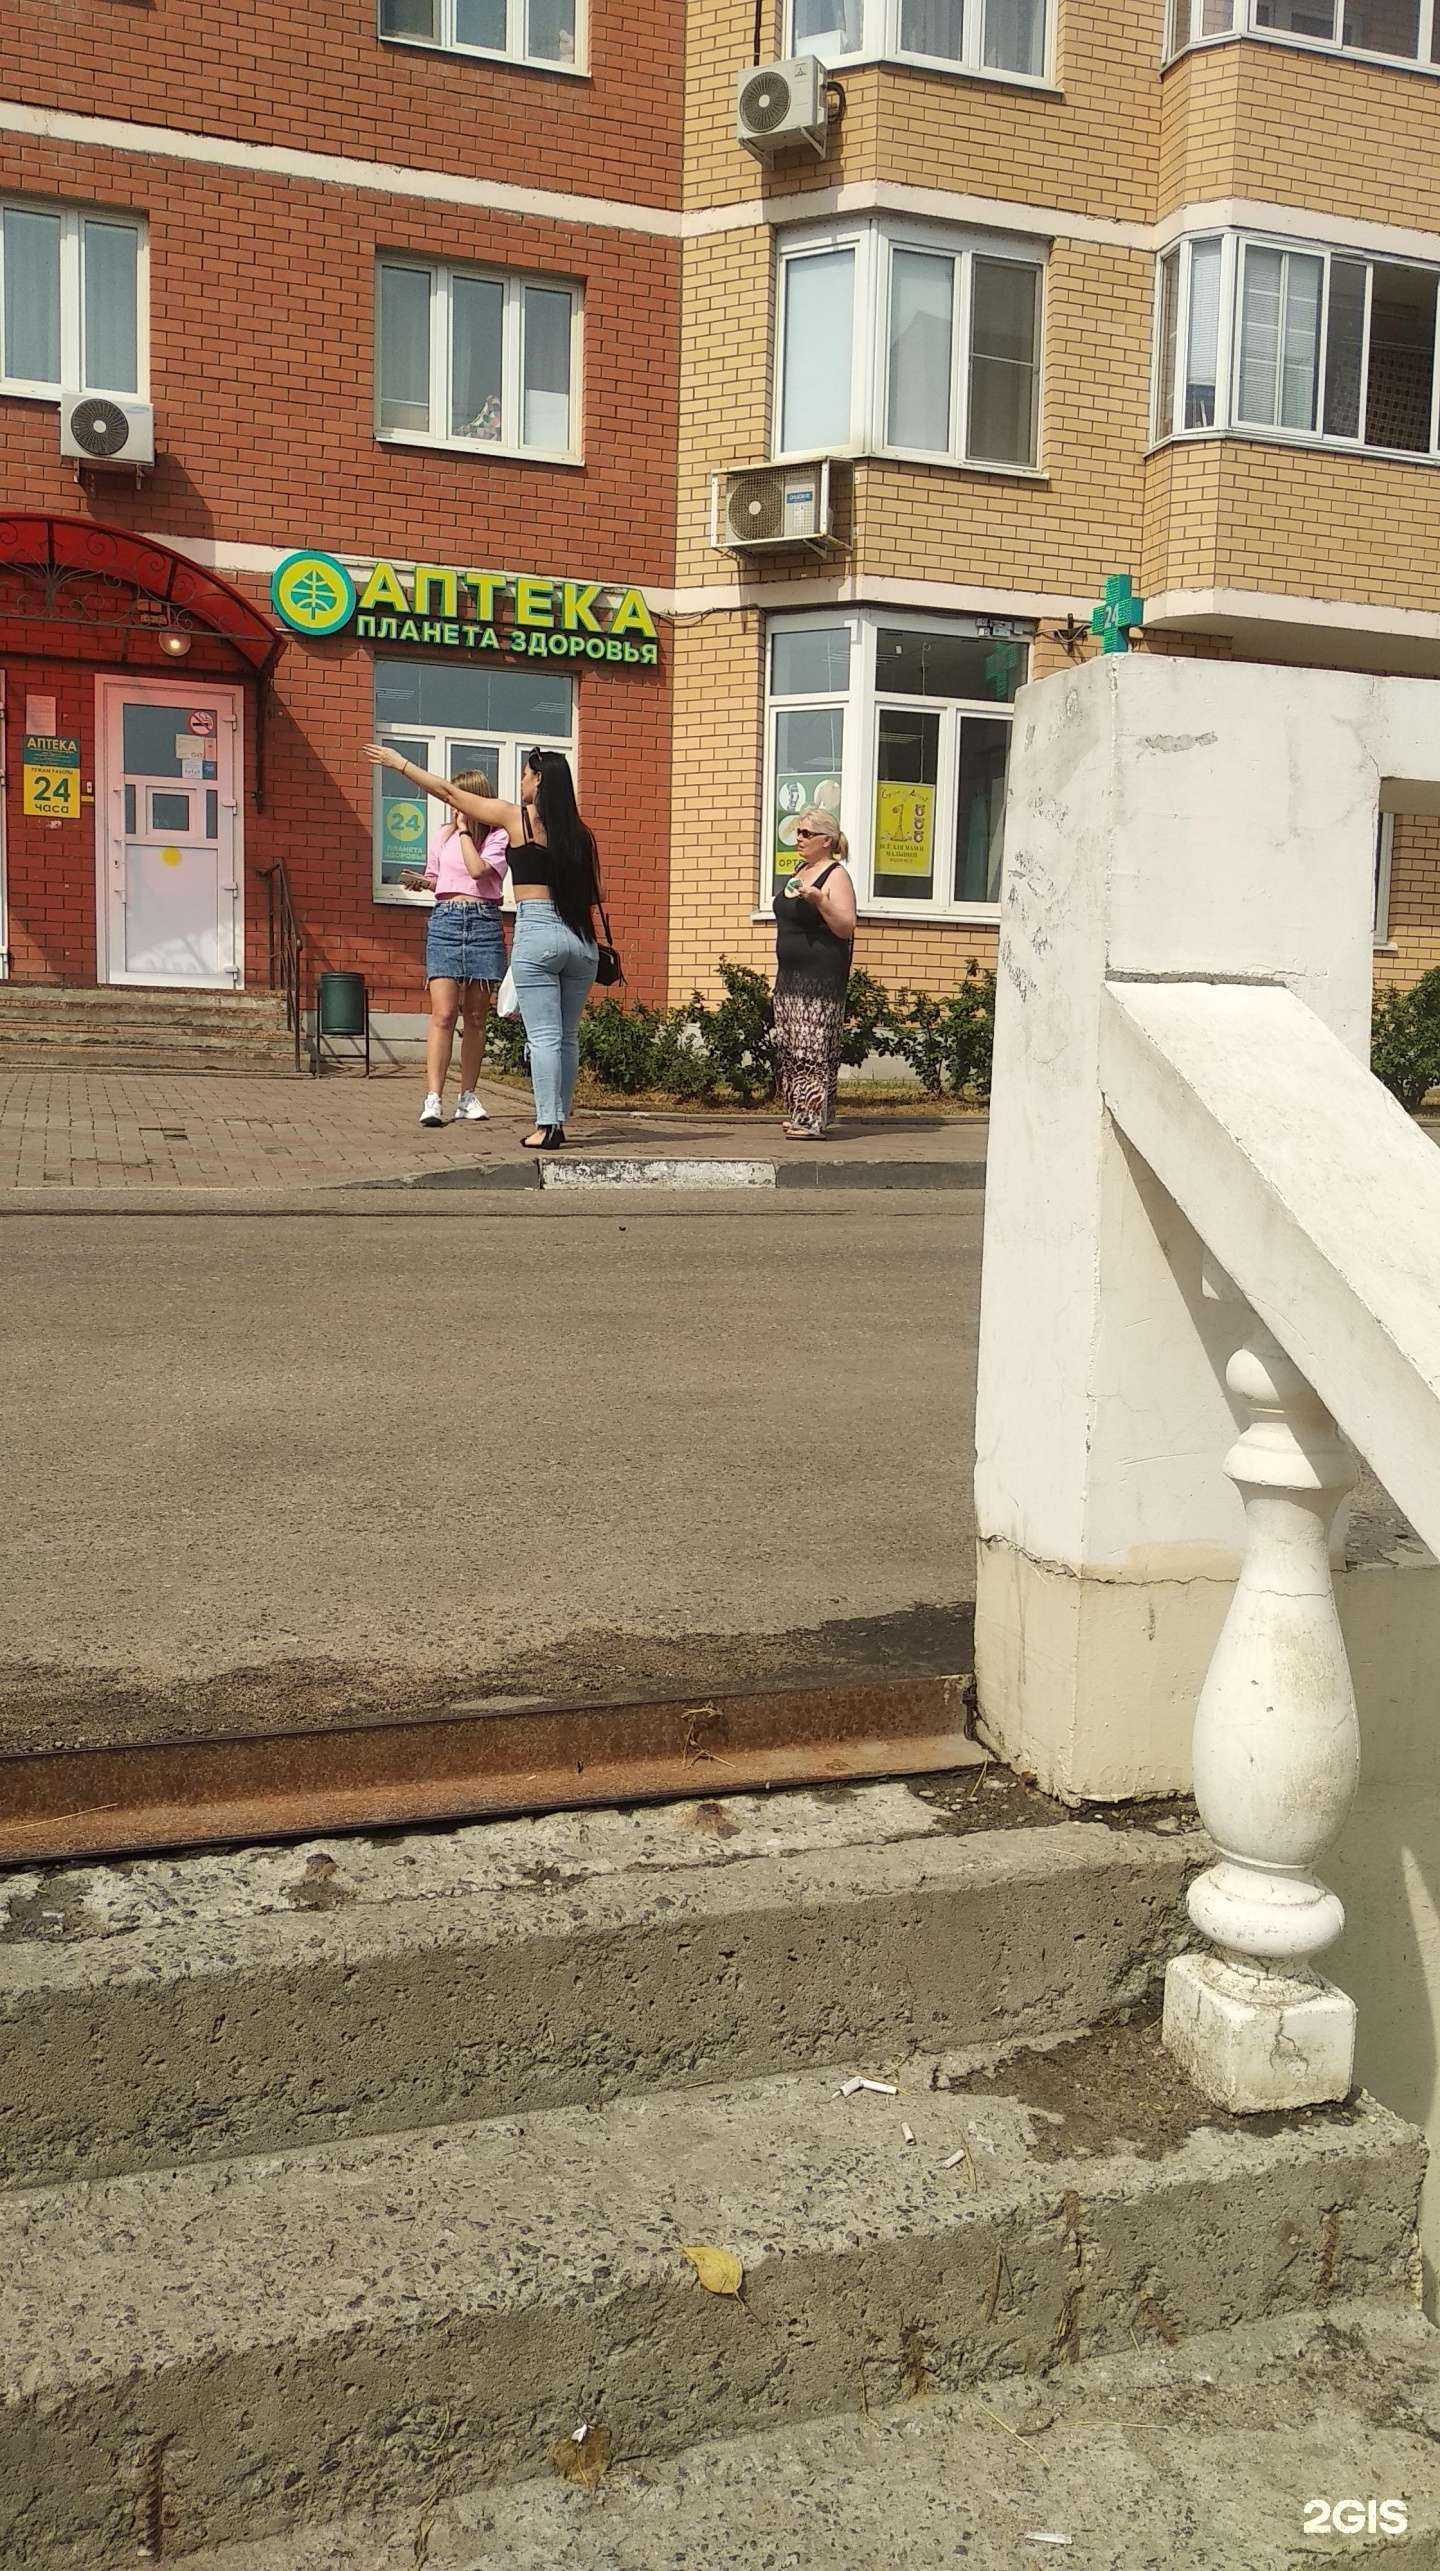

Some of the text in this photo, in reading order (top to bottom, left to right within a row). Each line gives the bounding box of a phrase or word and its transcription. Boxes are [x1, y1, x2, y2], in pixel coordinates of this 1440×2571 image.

[358, 562, 658, 638] АПТЕКА
[1104, 604, 1118, 629] 24
[357, 615, 658, 665] ПЛАНЕТА ЗДОРОВЬЯ
[27, 737, 77, 751] АПТЕКА
[33, 776, 71, 803] 24
[34, 804, 69, 814] часа
[391, 813, 420, 832] 24
